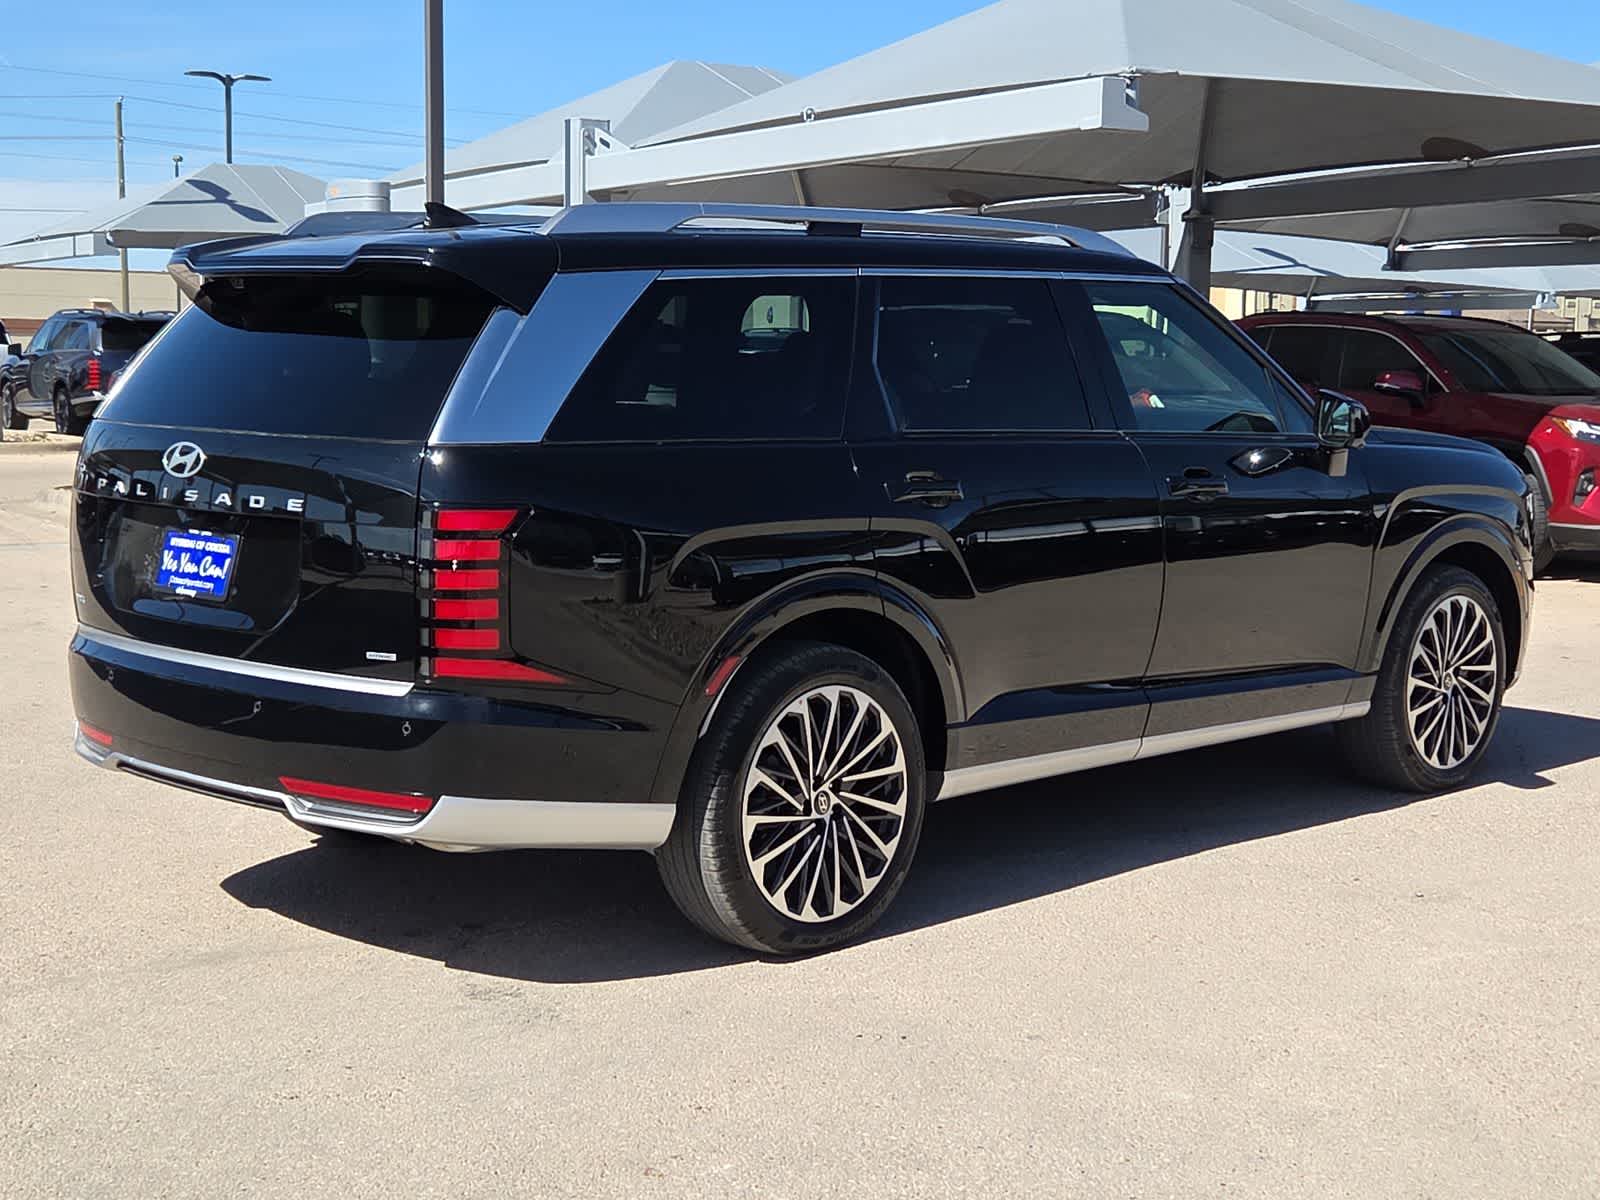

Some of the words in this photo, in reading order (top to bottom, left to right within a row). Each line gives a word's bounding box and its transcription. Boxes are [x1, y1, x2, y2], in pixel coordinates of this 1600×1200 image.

[97, 477, 305, 512] PALISADE
[161, 550, 178, 573] Yes
[179, 552, 198, 574] You
[199, 555, 231, 579] Can!
